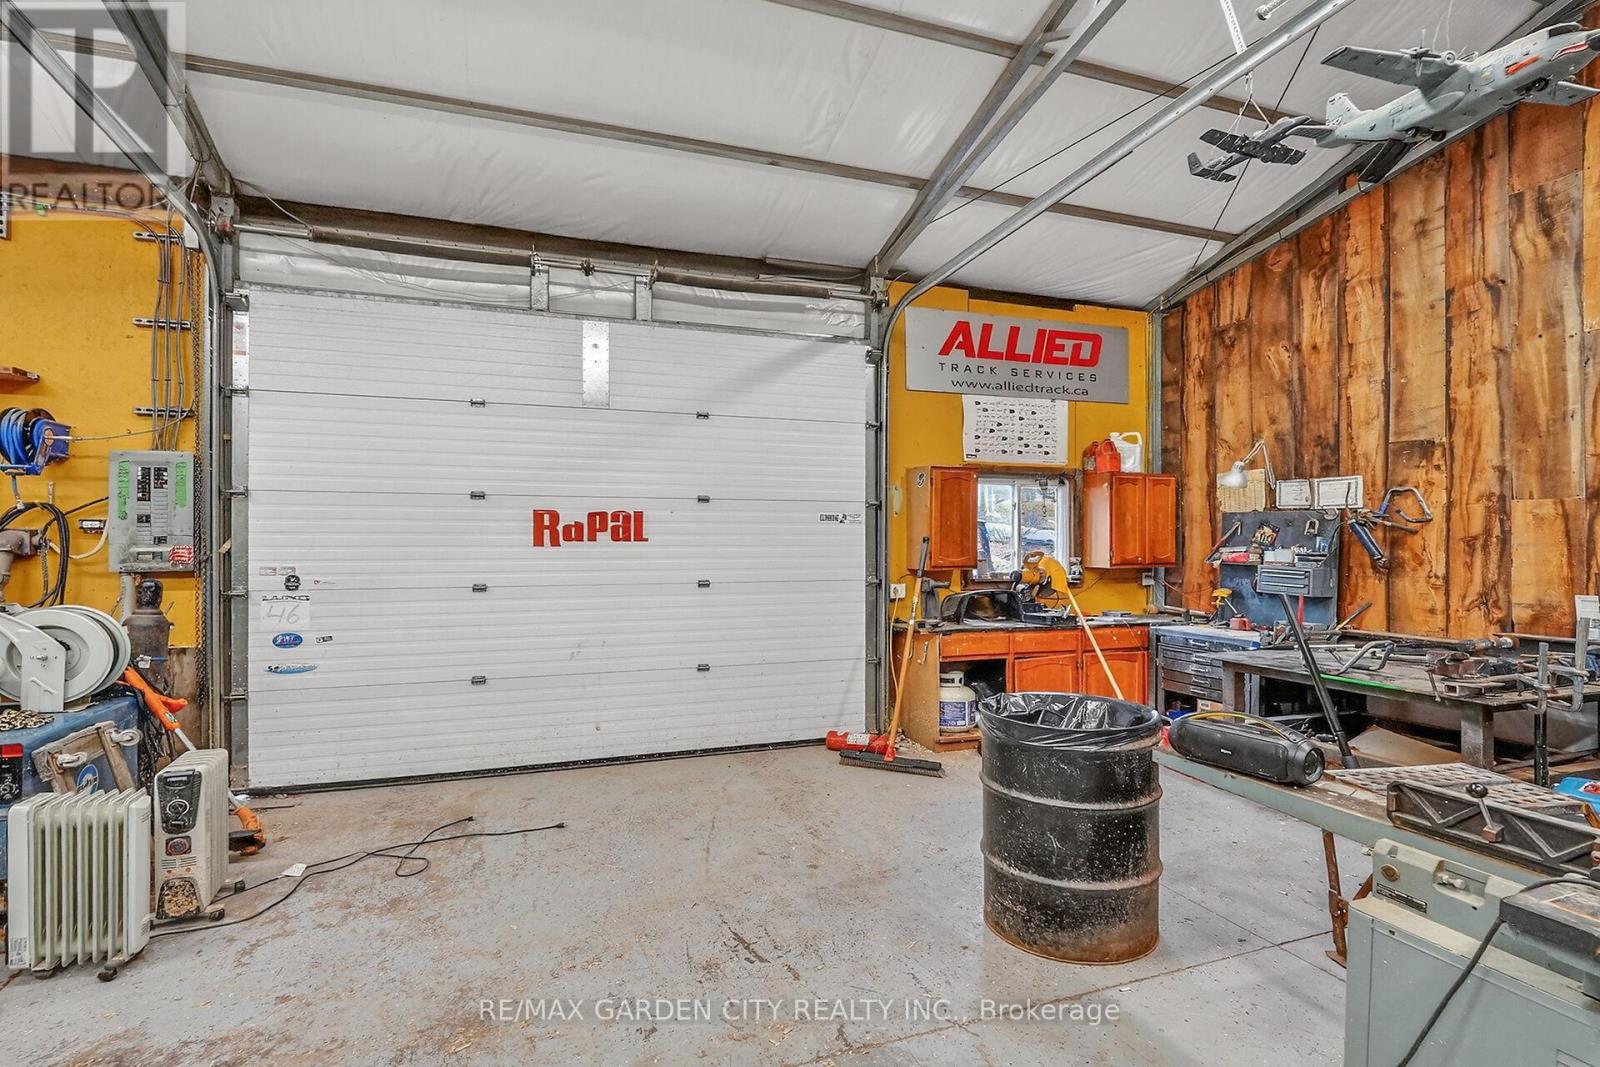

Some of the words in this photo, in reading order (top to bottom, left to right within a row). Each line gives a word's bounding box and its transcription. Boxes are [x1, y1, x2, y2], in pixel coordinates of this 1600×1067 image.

[938, 320, 1103, 367] ALLIED
[938, 362, 998, 375] TRACK
[1010, 368, 1098, 382] SERVICES
[951, 379, 1090, 396] www.alliedtrack.ca
[266, 604, 300, 625] 46
